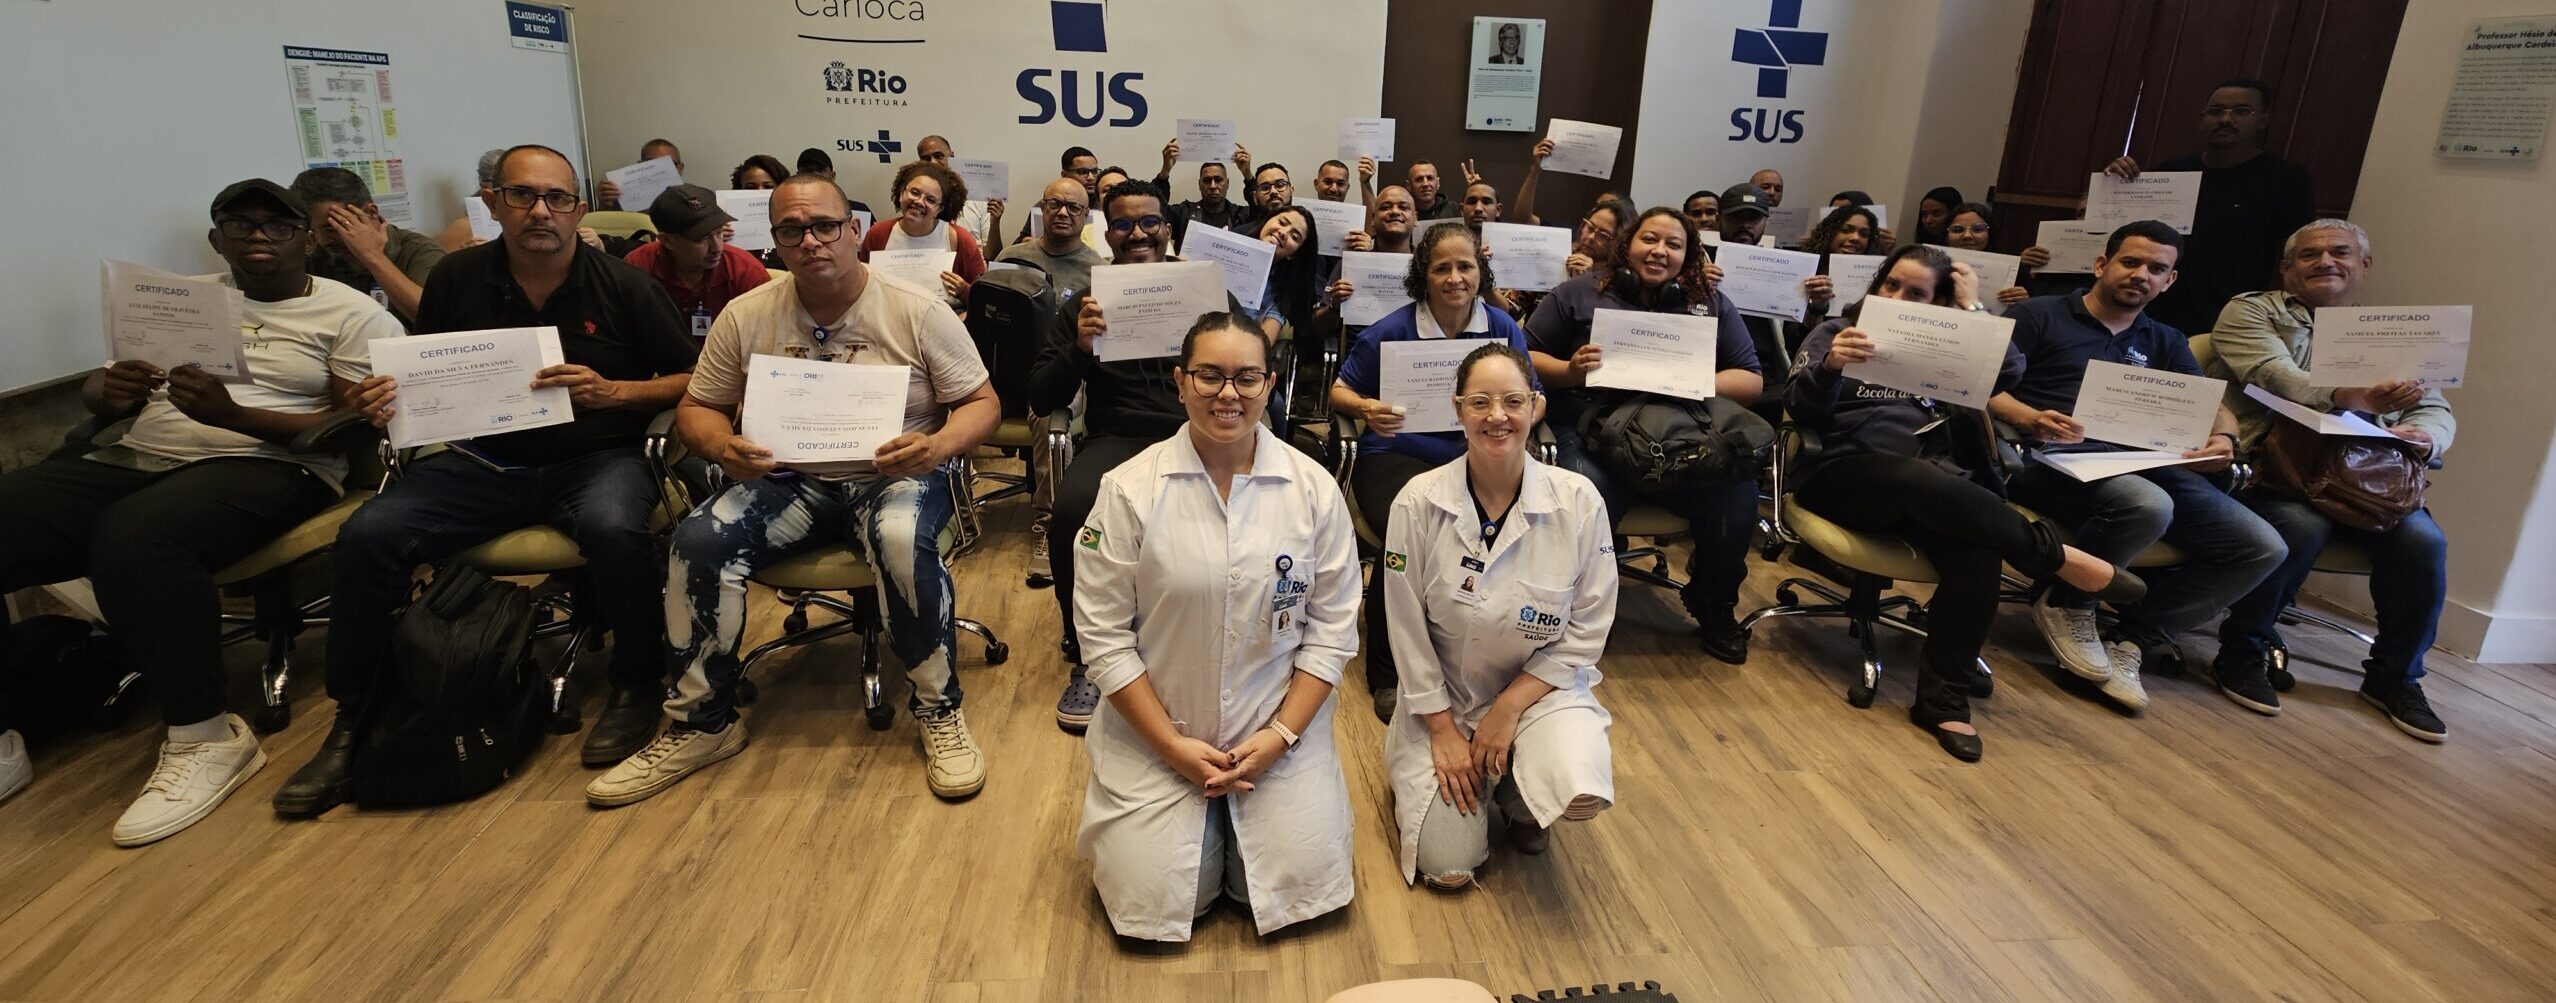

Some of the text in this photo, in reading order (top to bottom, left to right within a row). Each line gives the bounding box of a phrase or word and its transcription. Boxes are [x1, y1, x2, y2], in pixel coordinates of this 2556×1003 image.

[513, 10, 556, 24] CLASSIFICAÇÃO
[524, 23, 550, 34] DE RISCO
[2477, 32, 2517, 40] Professor
[2520, 30, 2544, 38] Hésio
[2466, 42, 2522, 50] Albuquerque
[858, 69, 907, 94] Rio
[826, 97, 908, 107] PREFEITURA
[1016, 68, 1148, 128] SUS
[1728, 108, 1804, 144] SUS
[837, 140, 864, 152] SUS
[1212, 242, 1248, 257] CERTIFICADO
[1749, 255, 1790, 264] CERTIFICADO
[135, 284, 190, 297] CERTIFICADO
[1124, 286, 1172, 296] CERTIFICADO
[1899, 314, 1959, 330] CERTIFICADO
[1631, 328, 1680, 341] CERTIFICADO
[420, 342, 495, 359] CERTIFICADO
[408, 370, 433, 378] DAVID
[470, 359, 514, 372] FERNANDES
[2124, 374, 2186, 388] CERTIFICADO
[1856, 386, 1896, 398] Escola
[498, 414, 514, 424] RIO
[798, 440, 860, 450] CERTIFICADO
[1600, 546, 1615, 554] SUS
[1291, 581, 1308, 594] Rio
[1537, 612, 1560, 626] Rio
